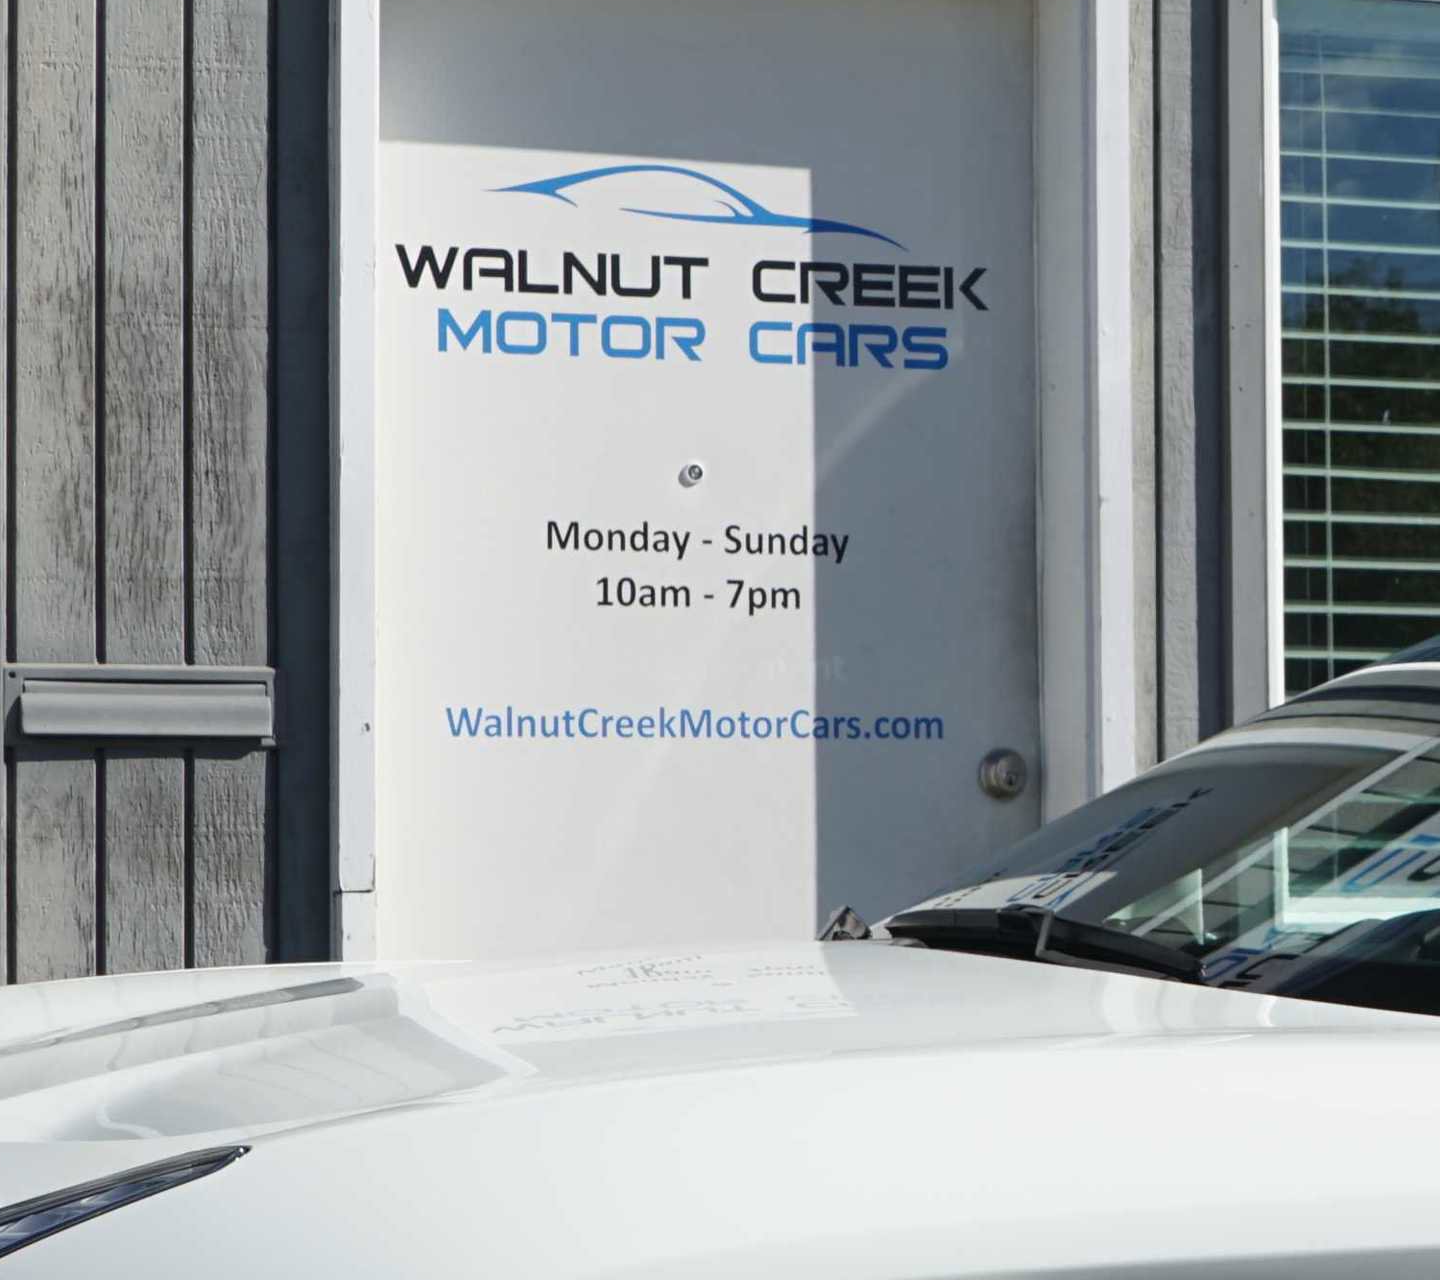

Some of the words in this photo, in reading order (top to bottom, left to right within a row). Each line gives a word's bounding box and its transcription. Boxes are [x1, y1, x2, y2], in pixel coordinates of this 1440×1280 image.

[395, 244, 709, 299] WALNUT
[752, 260, 989, 311] CREEK
[437, 307, 707, 361] MOTOR
[748, 321, 949, 371] CARS
[546, 520, 691, 560] Monday
[725, 524, 850, 564] Sunday
[596, 576, 692, 608] 10am
[726, 579, 802, 617] 7pm
[445, 706, 944, 741] WalnutCreekMotorCars.com
